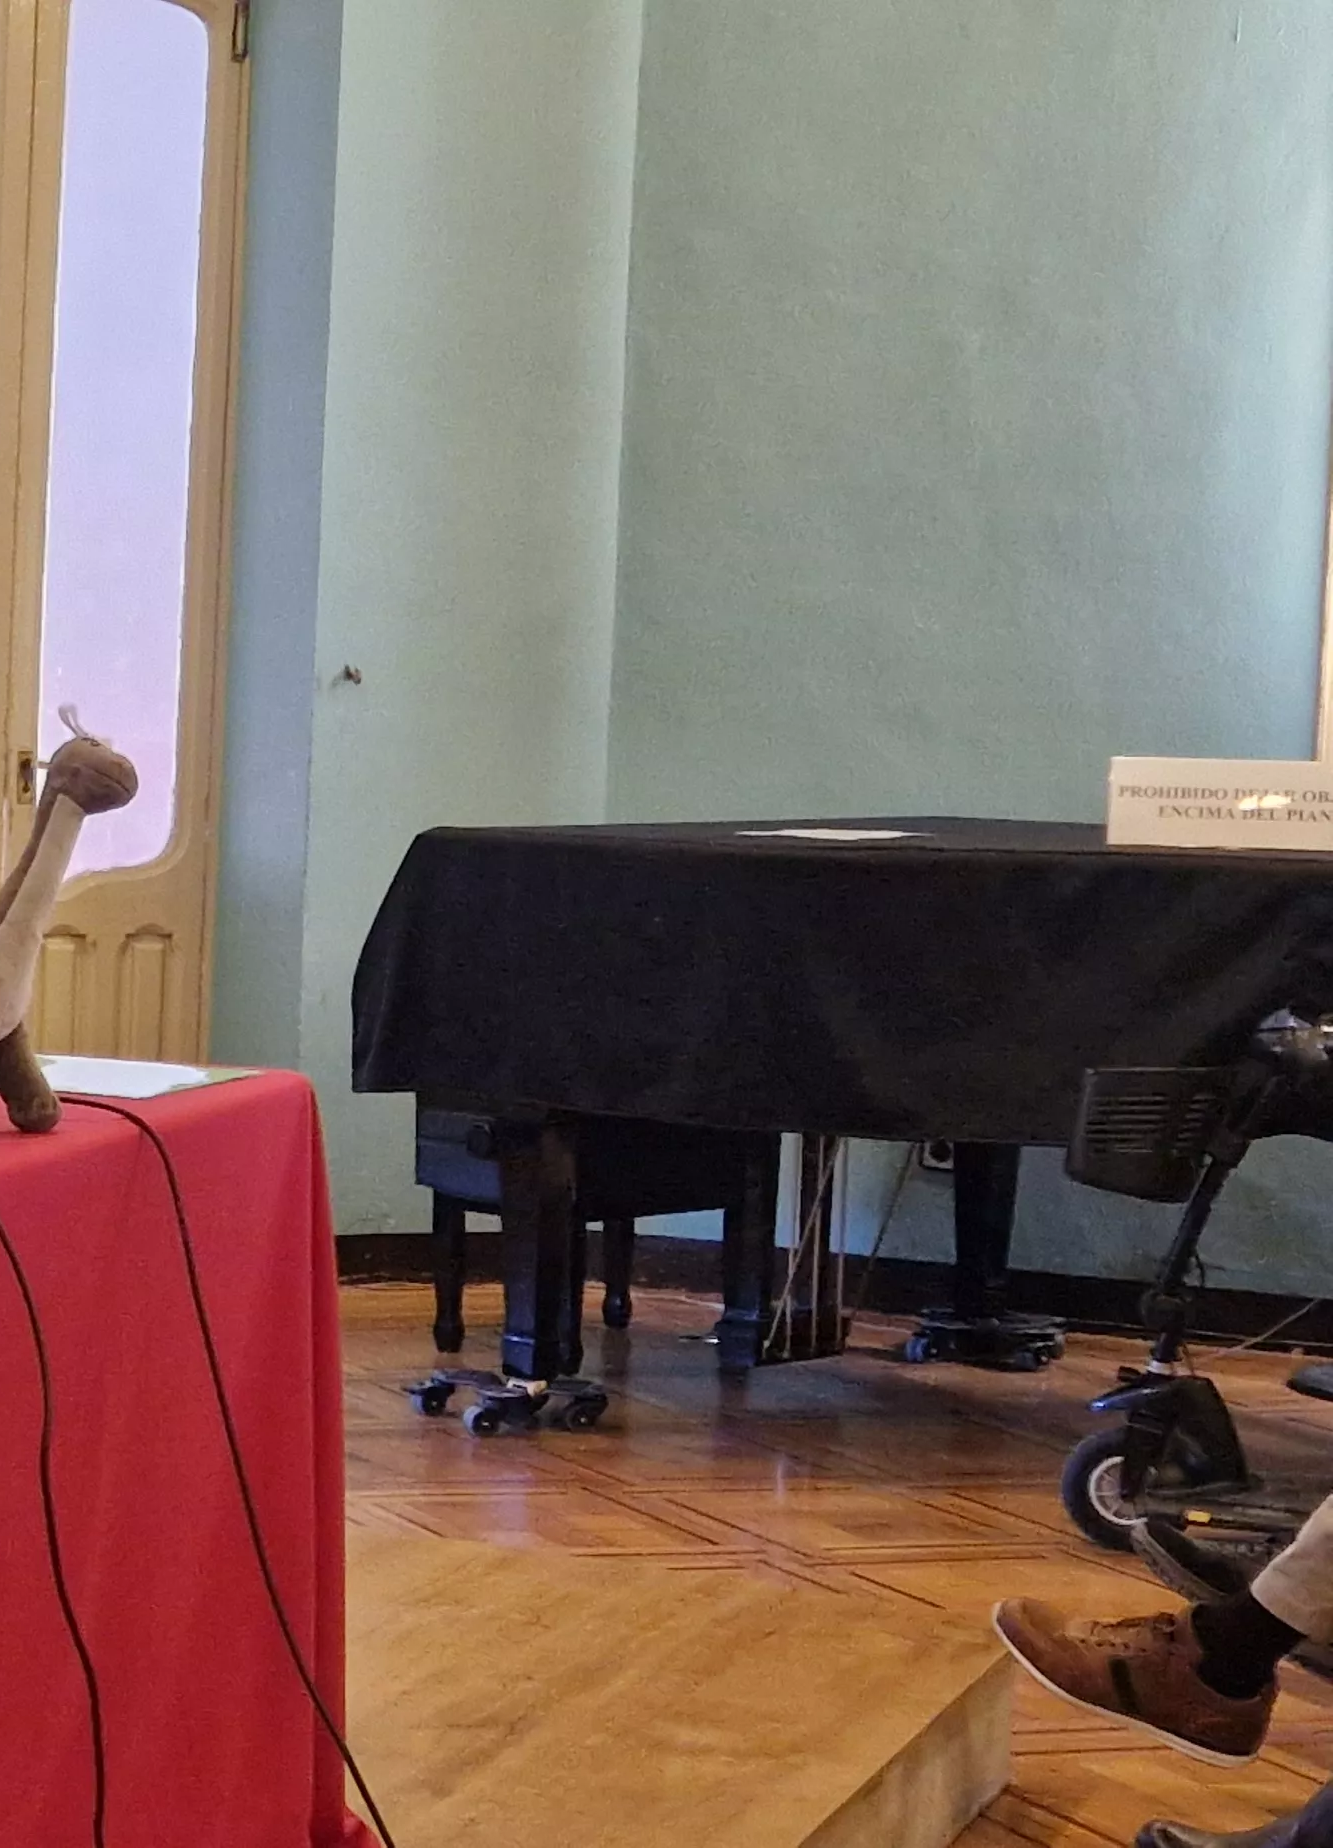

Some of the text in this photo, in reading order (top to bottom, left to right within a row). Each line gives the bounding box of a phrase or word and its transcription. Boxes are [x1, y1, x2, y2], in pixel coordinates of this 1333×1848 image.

[1118, 785, 1229, 801] PROHIBIDO
[1158, 805, 1236, 820] ENCIMA
[1240, 808, 1278, 821] DEL
